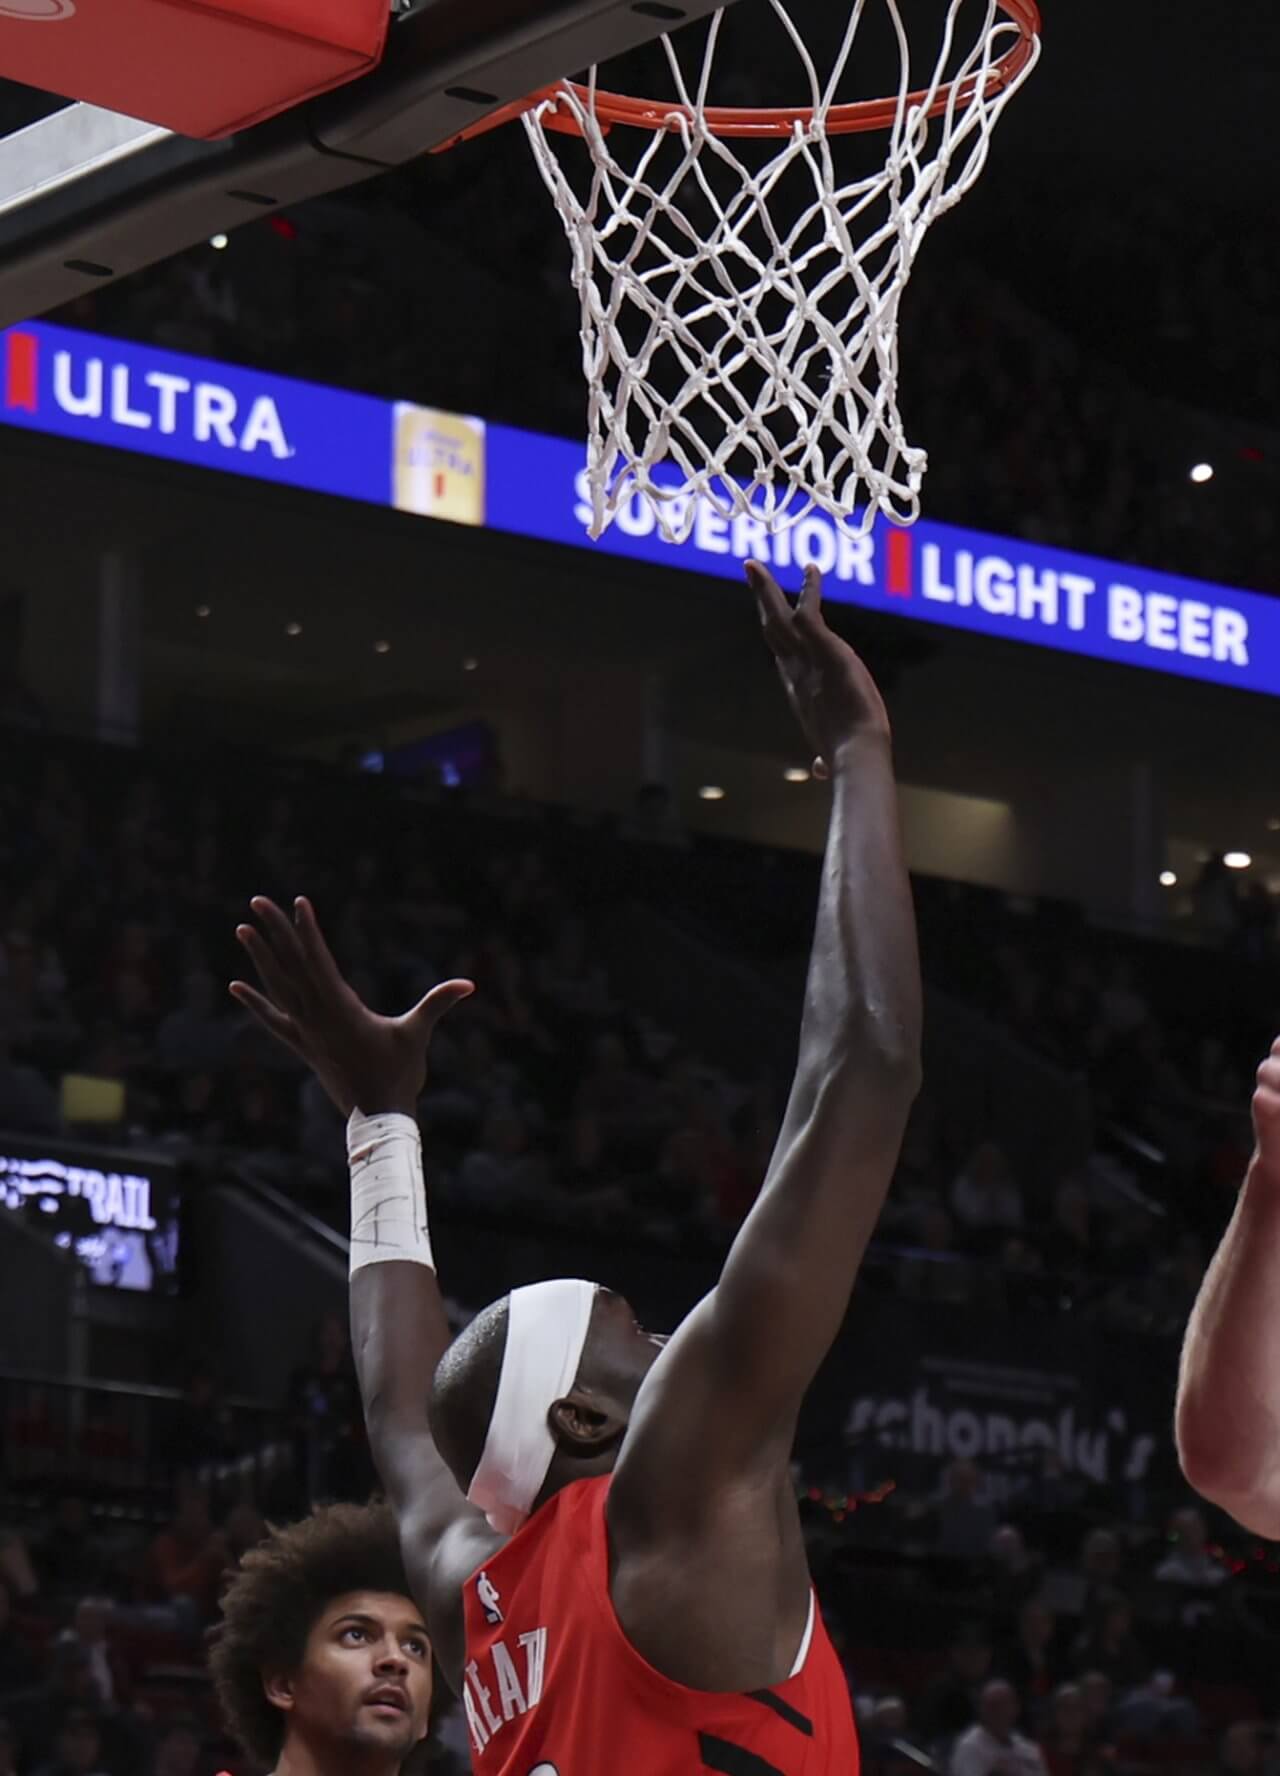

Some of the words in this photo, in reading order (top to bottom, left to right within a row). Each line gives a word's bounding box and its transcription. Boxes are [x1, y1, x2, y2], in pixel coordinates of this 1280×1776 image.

[53, 350, 291, 459] ULTRA
[573, 466, 876, 586] SUPERIOR
[922, 542, 1095, 631] LIGHT
[1107, 584, 1249, 666] BEER
